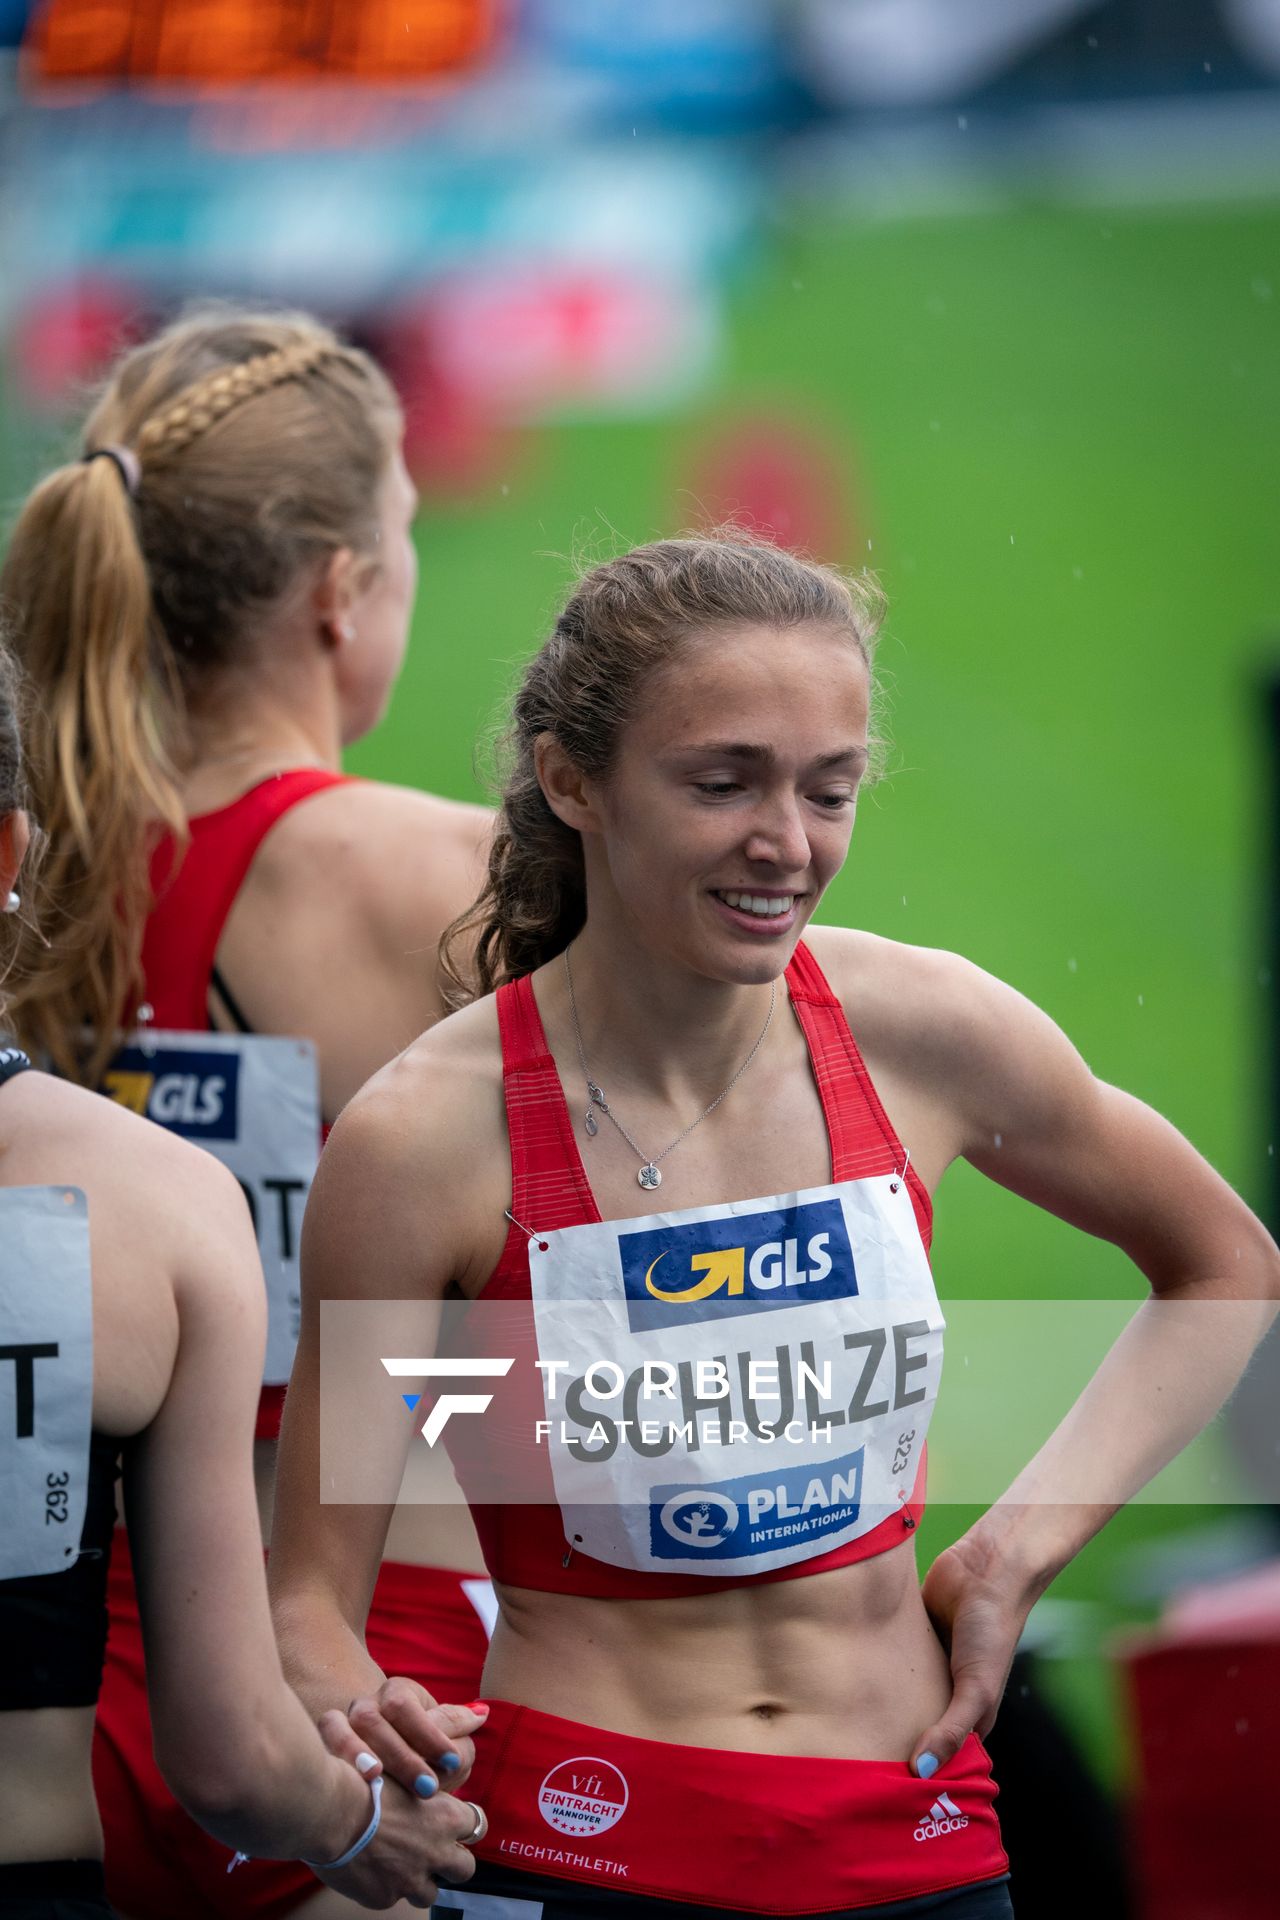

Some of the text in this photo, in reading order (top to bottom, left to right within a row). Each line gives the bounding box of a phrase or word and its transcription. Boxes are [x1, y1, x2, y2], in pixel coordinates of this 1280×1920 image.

[150, 1073, 226, 1125] GLS
[749, 1232, 832, 1291] GLS
[565, 1319, 930, 1463] SCHULZE
[891, 1429, 916, 1475] 323
[45, 1471, 70, 1525] 362
[747, 1467, 857, 1525] PLAN
[750, 1506, 853, 1544] INTERNATIONAL
[541, 1792, 620, 1819] EINTRACHT
[552, 1807, 602, 1825] HANNOVER
[913, 1815, 969, 1841] adidas
[499, 1839, 629, 1877] LEICHTATHLETIK
